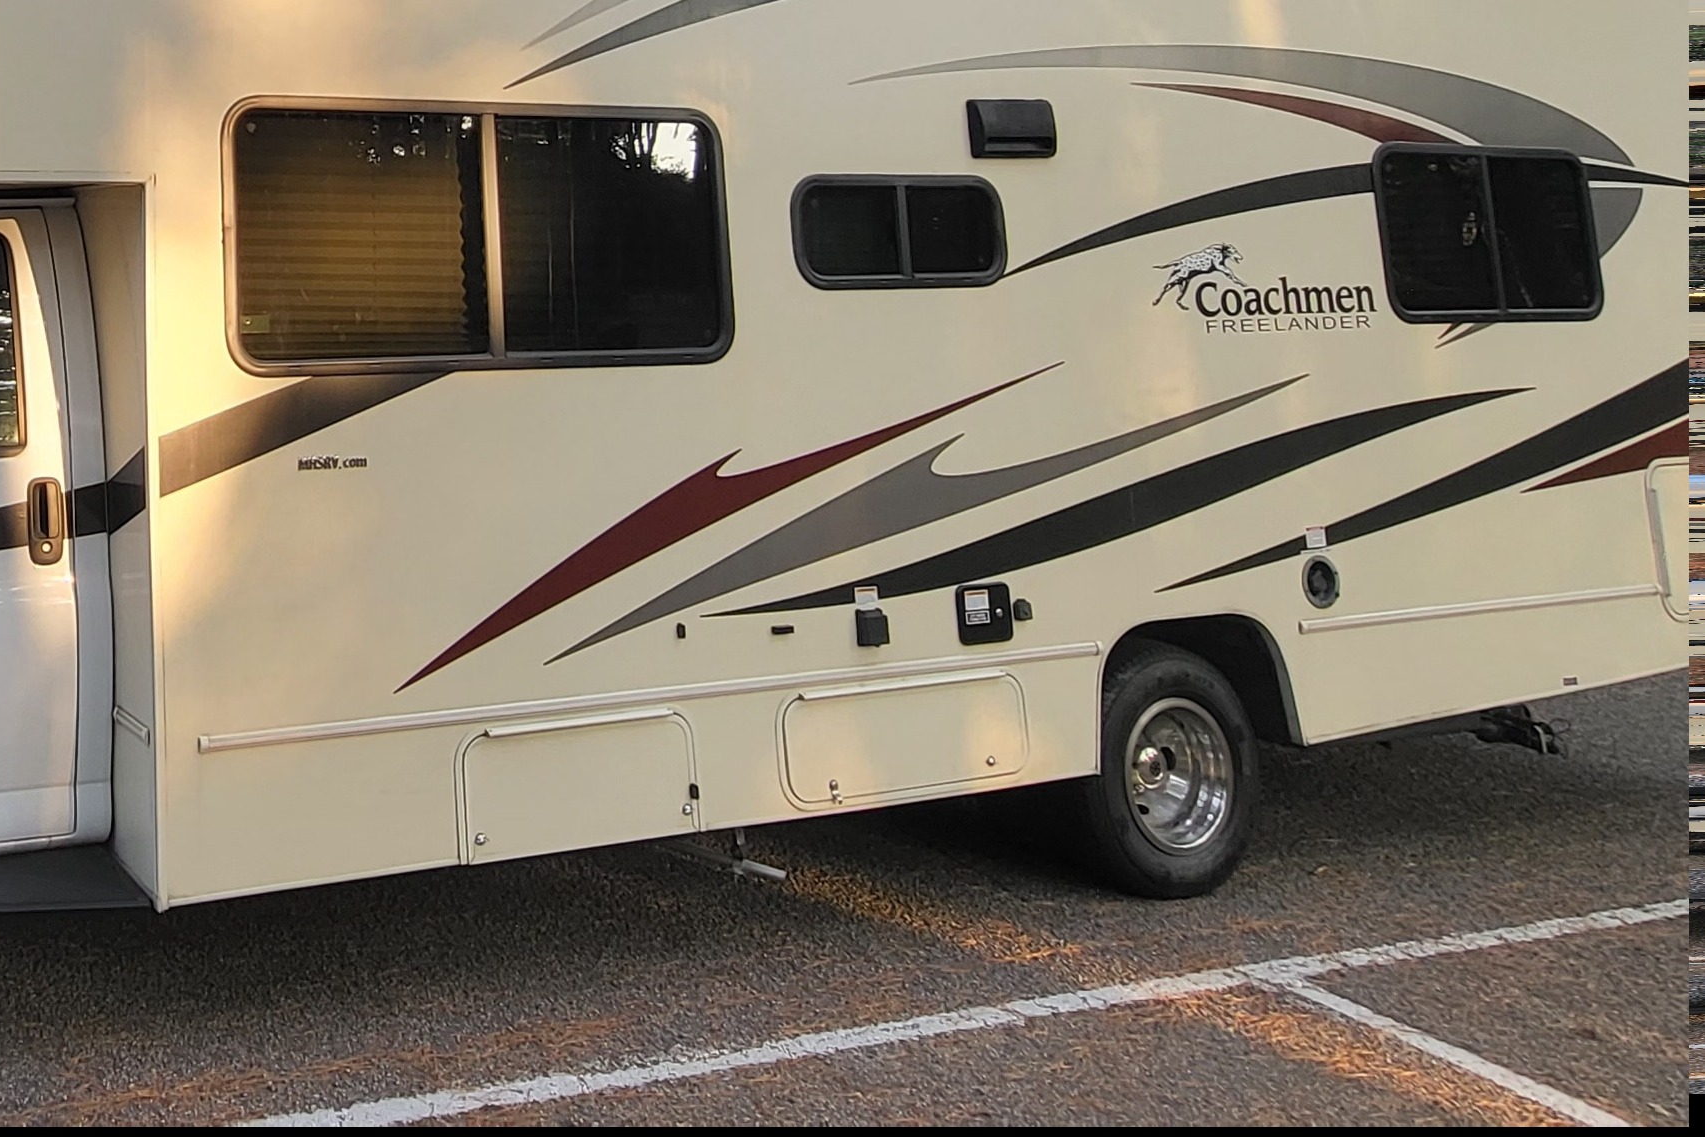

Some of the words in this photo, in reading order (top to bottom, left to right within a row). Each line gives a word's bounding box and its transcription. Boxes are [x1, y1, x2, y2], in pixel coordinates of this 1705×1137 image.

[1195, 277, 1377, 318] Coachmen
[1206, 315, 1372, 334] FREELANDER
[298, 457, 367, 471] MHSRV.com
